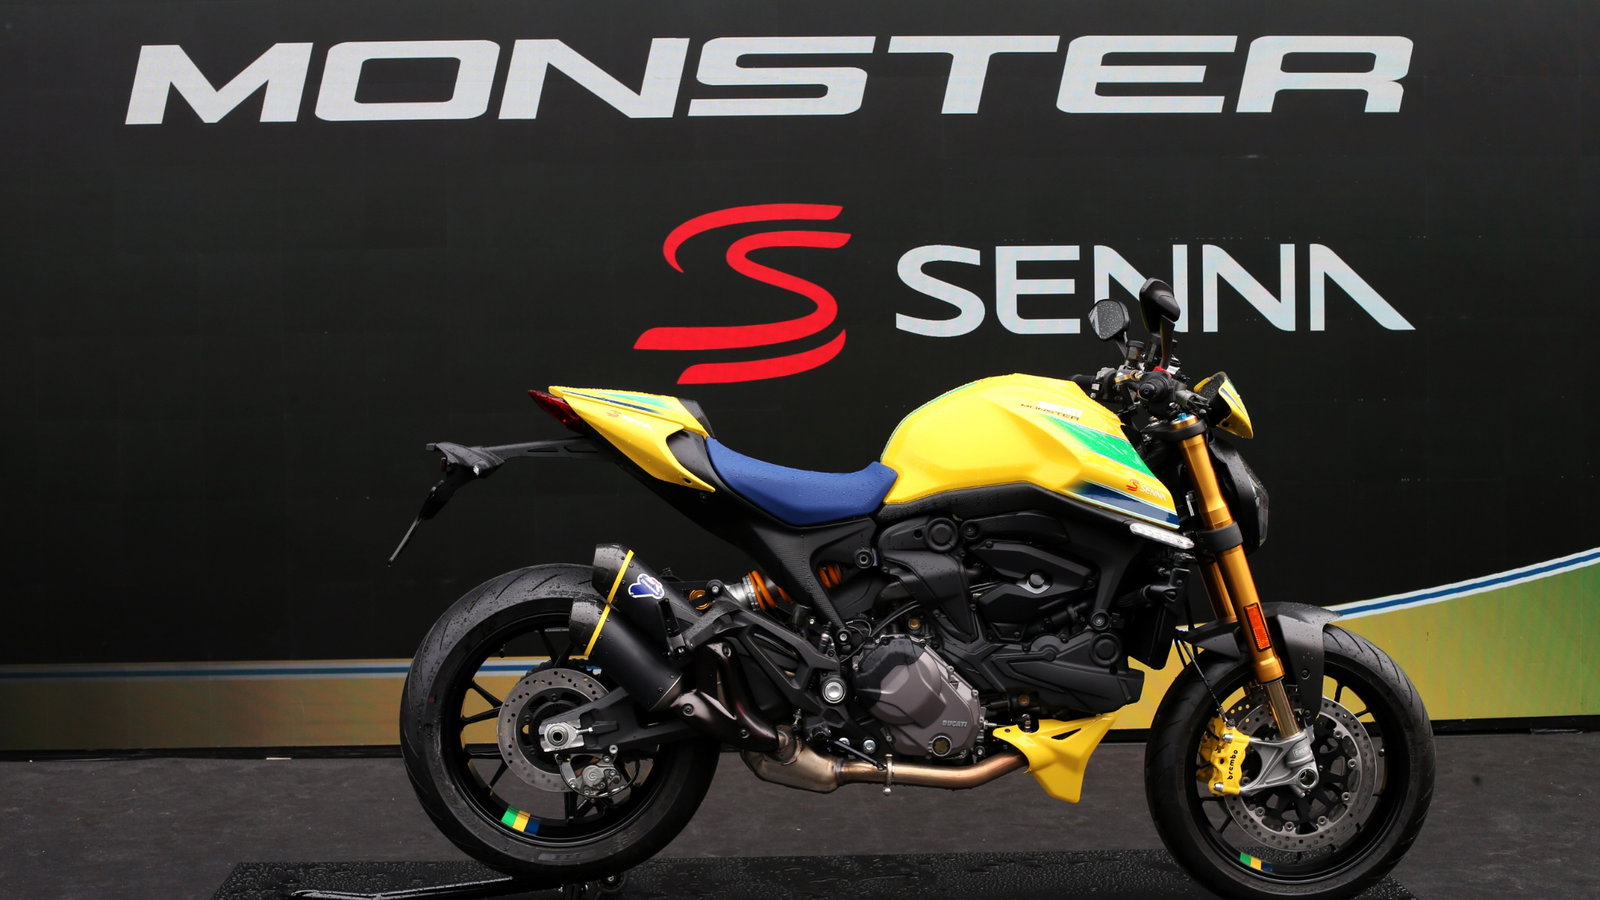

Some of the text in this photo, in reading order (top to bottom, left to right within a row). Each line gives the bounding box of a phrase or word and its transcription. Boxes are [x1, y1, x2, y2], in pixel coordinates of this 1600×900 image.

[125, 36, 1413, 124] MONSTER
[896, 244, 1415, 337] SENNA
[1020, 403, 1080, 421] MONSTER
[1140, 486, 1166, 500] SENNA
[942, 719, 968, 728] DUCATI
[1227, 749, 1238, 780] brembo
